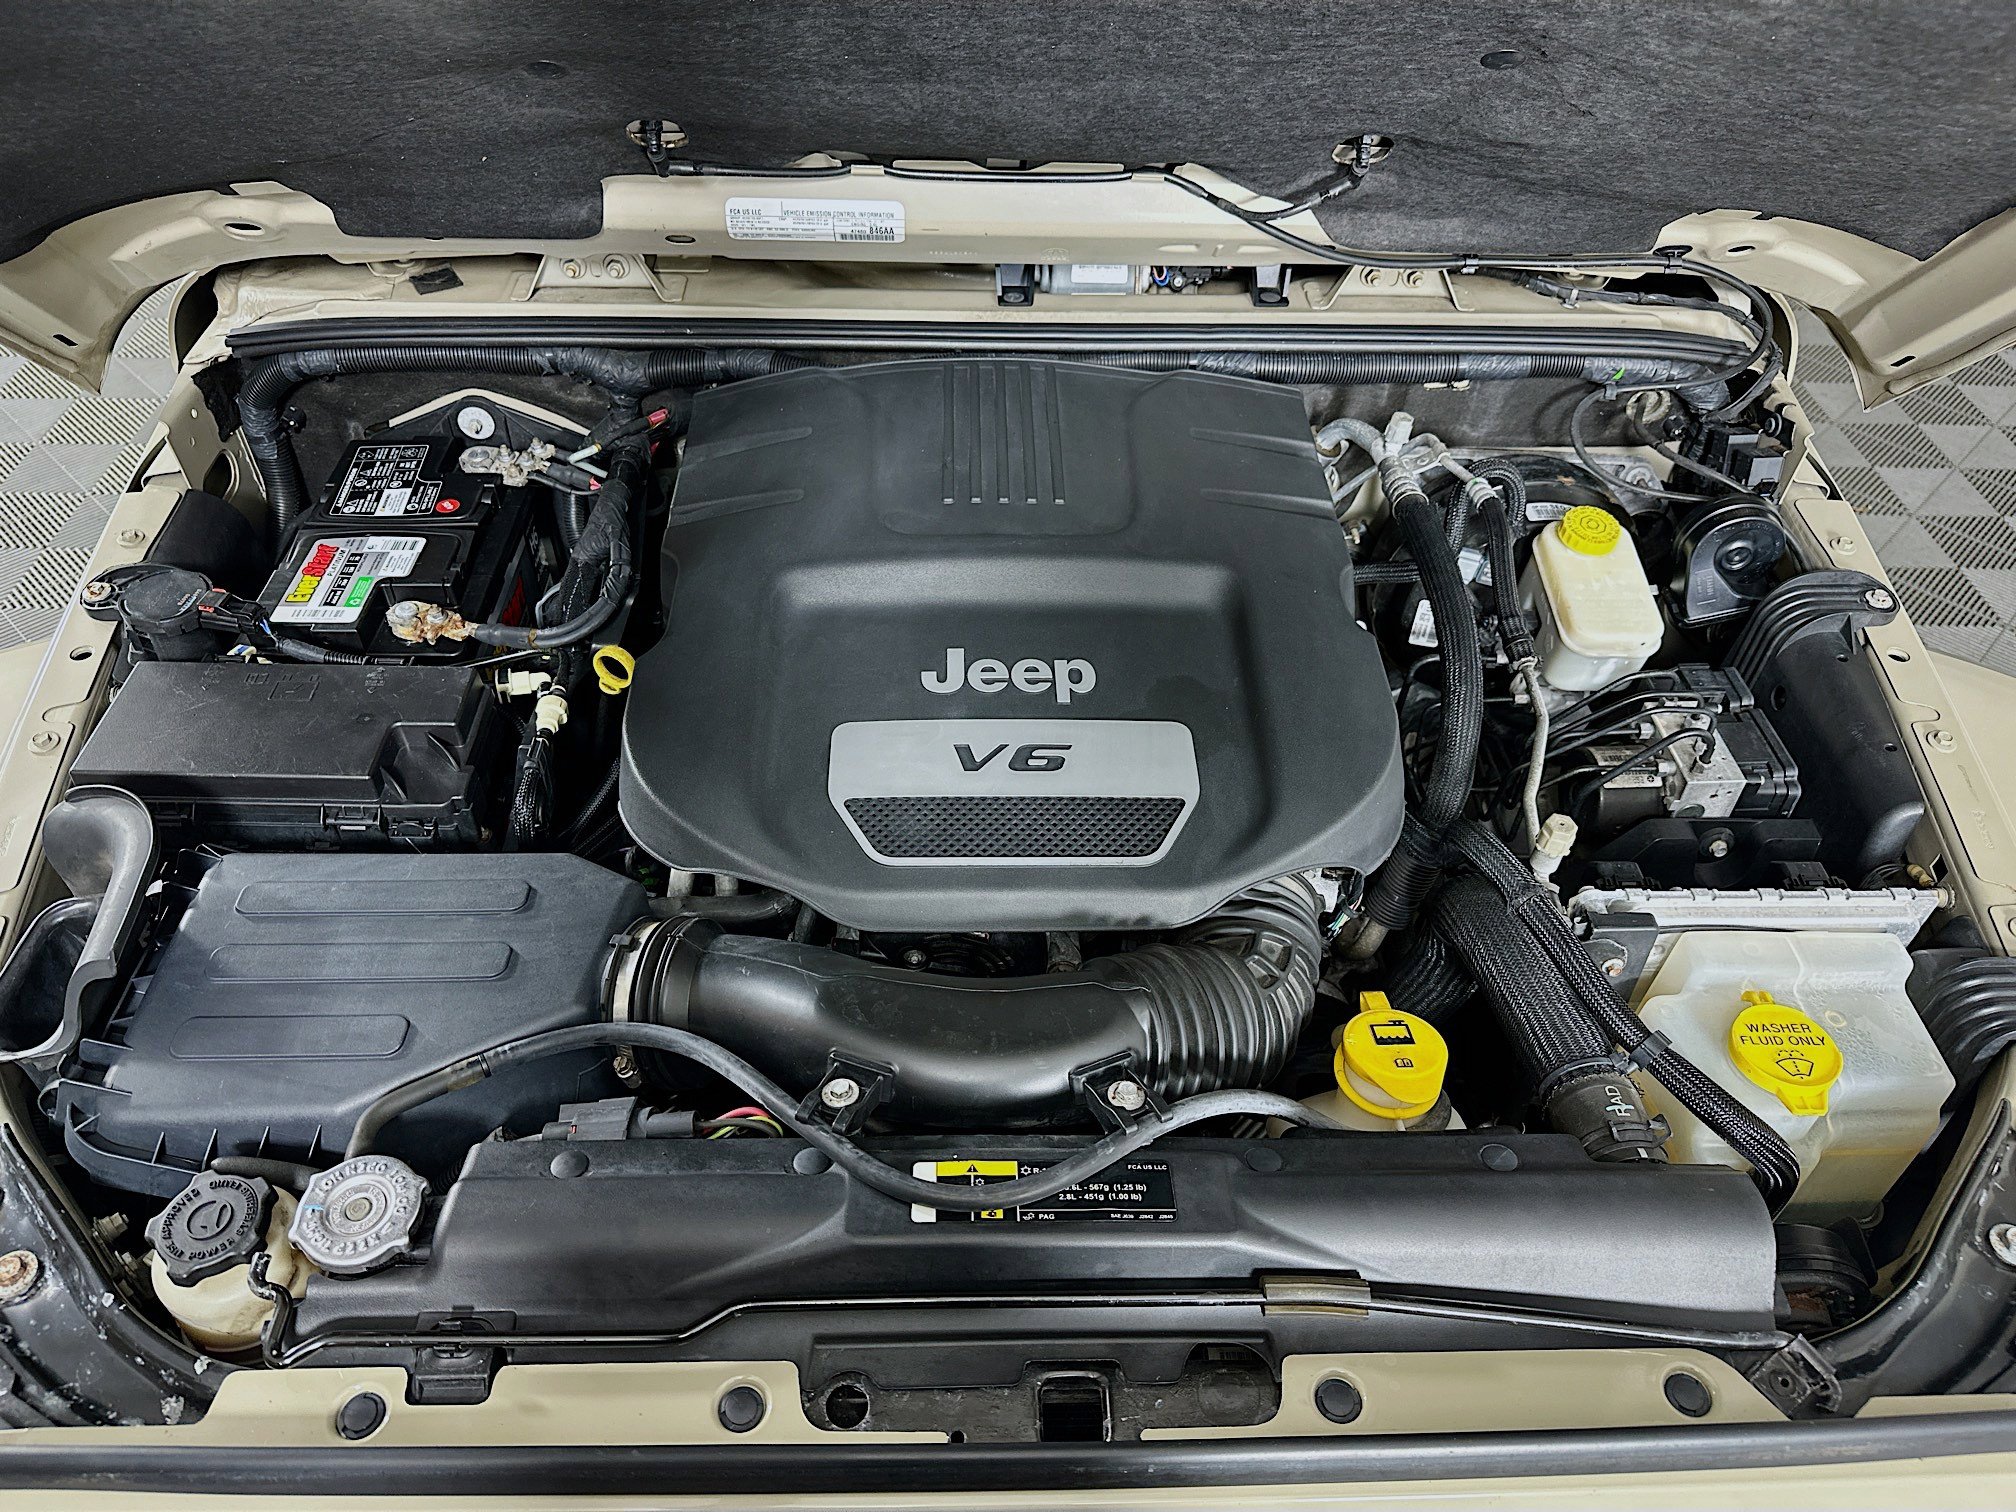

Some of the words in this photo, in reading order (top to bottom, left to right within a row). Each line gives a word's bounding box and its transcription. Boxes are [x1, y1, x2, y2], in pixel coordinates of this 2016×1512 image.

[858, 211, 895, 219] INFORMATION
[869, 226, 895, 235] 846AA
[285, 544, 340, 602] EverStart
[327, 550, 346, 577] PLATINUM
[920, 648, 1097, 705] Jeep
[953, 744, 1073, 772] V6
[1745, 1023, 1812, 1033] WASHER
[1740, 1035, 1784, 1046] FLUID
[1788, 1036, 1825, 1046] ONLY
[1604, 1085, 1631, 1116] RAD
[345, 1162, 388, 1176] OPEN
[209, 1180, 243, 1190] FLUID
[315, 1170, 344, 1197] HOT
[1088, 1184, 1110, 1192] 567g
[1114, 1184, 1134, 1192] (1.25
[1136, 1184, 1147, 1192] lb)
[1084, 1193, 1104, 1201] 451g
[1108, 1193, 1129, 1201] (1.00
[1130, 1193, 1142, 1202] lb)
[162, 1188, 201, 1240] APPROVED
[236, 1188, 257, 1236] STEERING
[165, 1240, 186, 1258] USE
[188, 1238, 236, 1260] POWER
